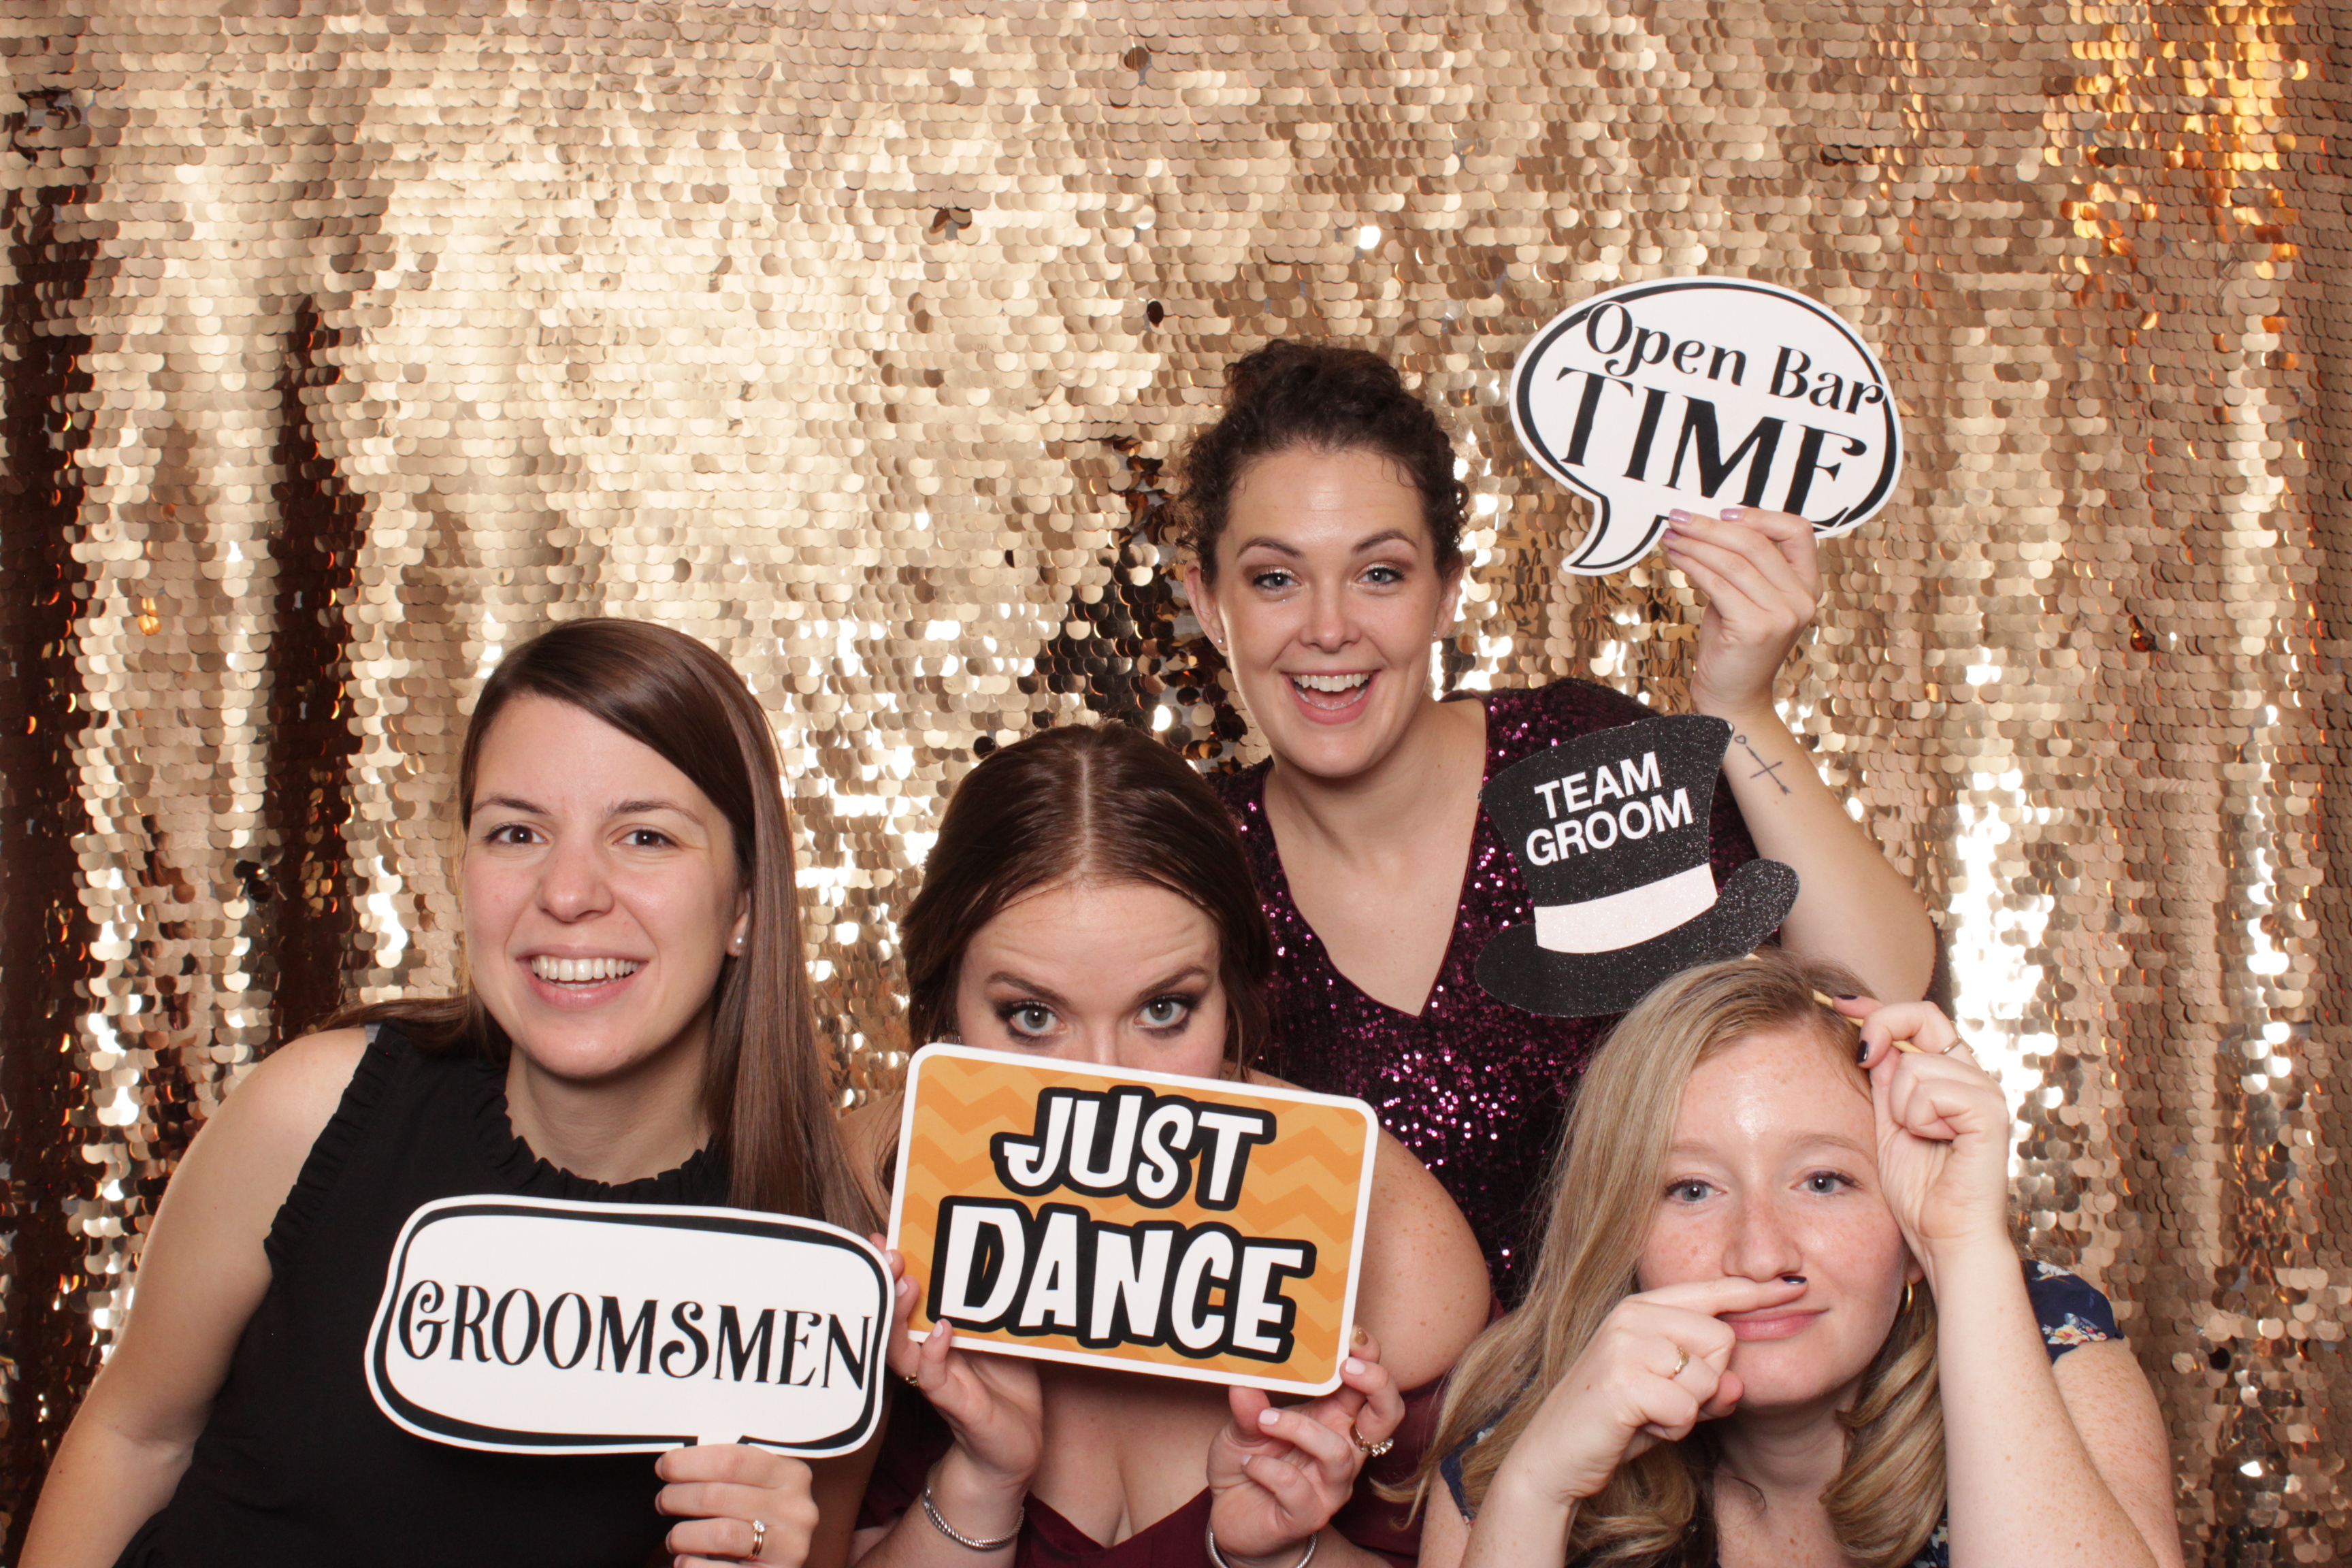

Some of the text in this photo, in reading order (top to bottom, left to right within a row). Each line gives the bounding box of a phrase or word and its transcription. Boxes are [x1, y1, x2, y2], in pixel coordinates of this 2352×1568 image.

[1586, 303, 1884, 415] Open Bar
[1556, 366, 1867, 528] TIME
[1525, 787, 1694, 866] GROOM
[1534, 751, 1663, 819] TEAM
[1002, 1094, 1264, 1203] JUST
[398, 1279, 873, 1391] GROOMSMEN
[939, 1204, 1305, 1354] DANCE
